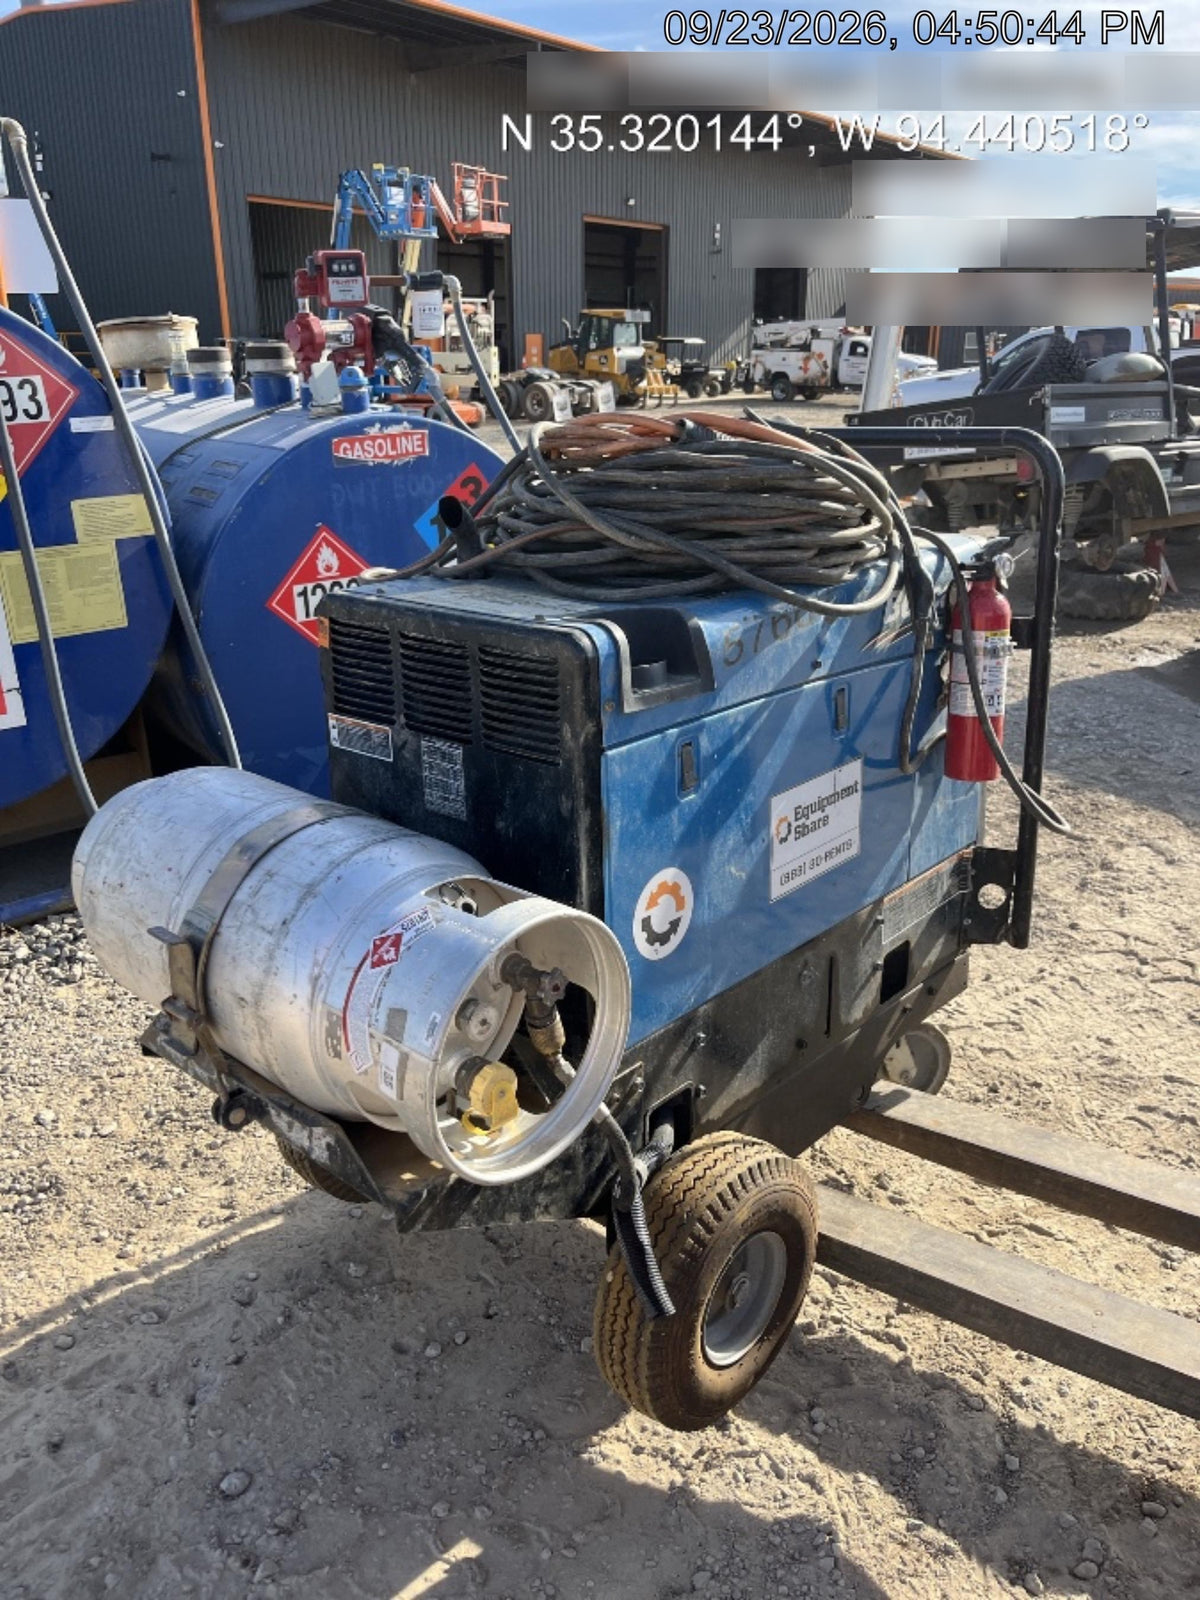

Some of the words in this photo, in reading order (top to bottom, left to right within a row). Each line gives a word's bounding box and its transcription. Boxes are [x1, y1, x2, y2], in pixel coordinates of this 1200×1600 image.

[338, 434, 424, 458] GASOLINE
[793, 780, 860, 821] Equipment
[793, 814, 830, 841] Share
